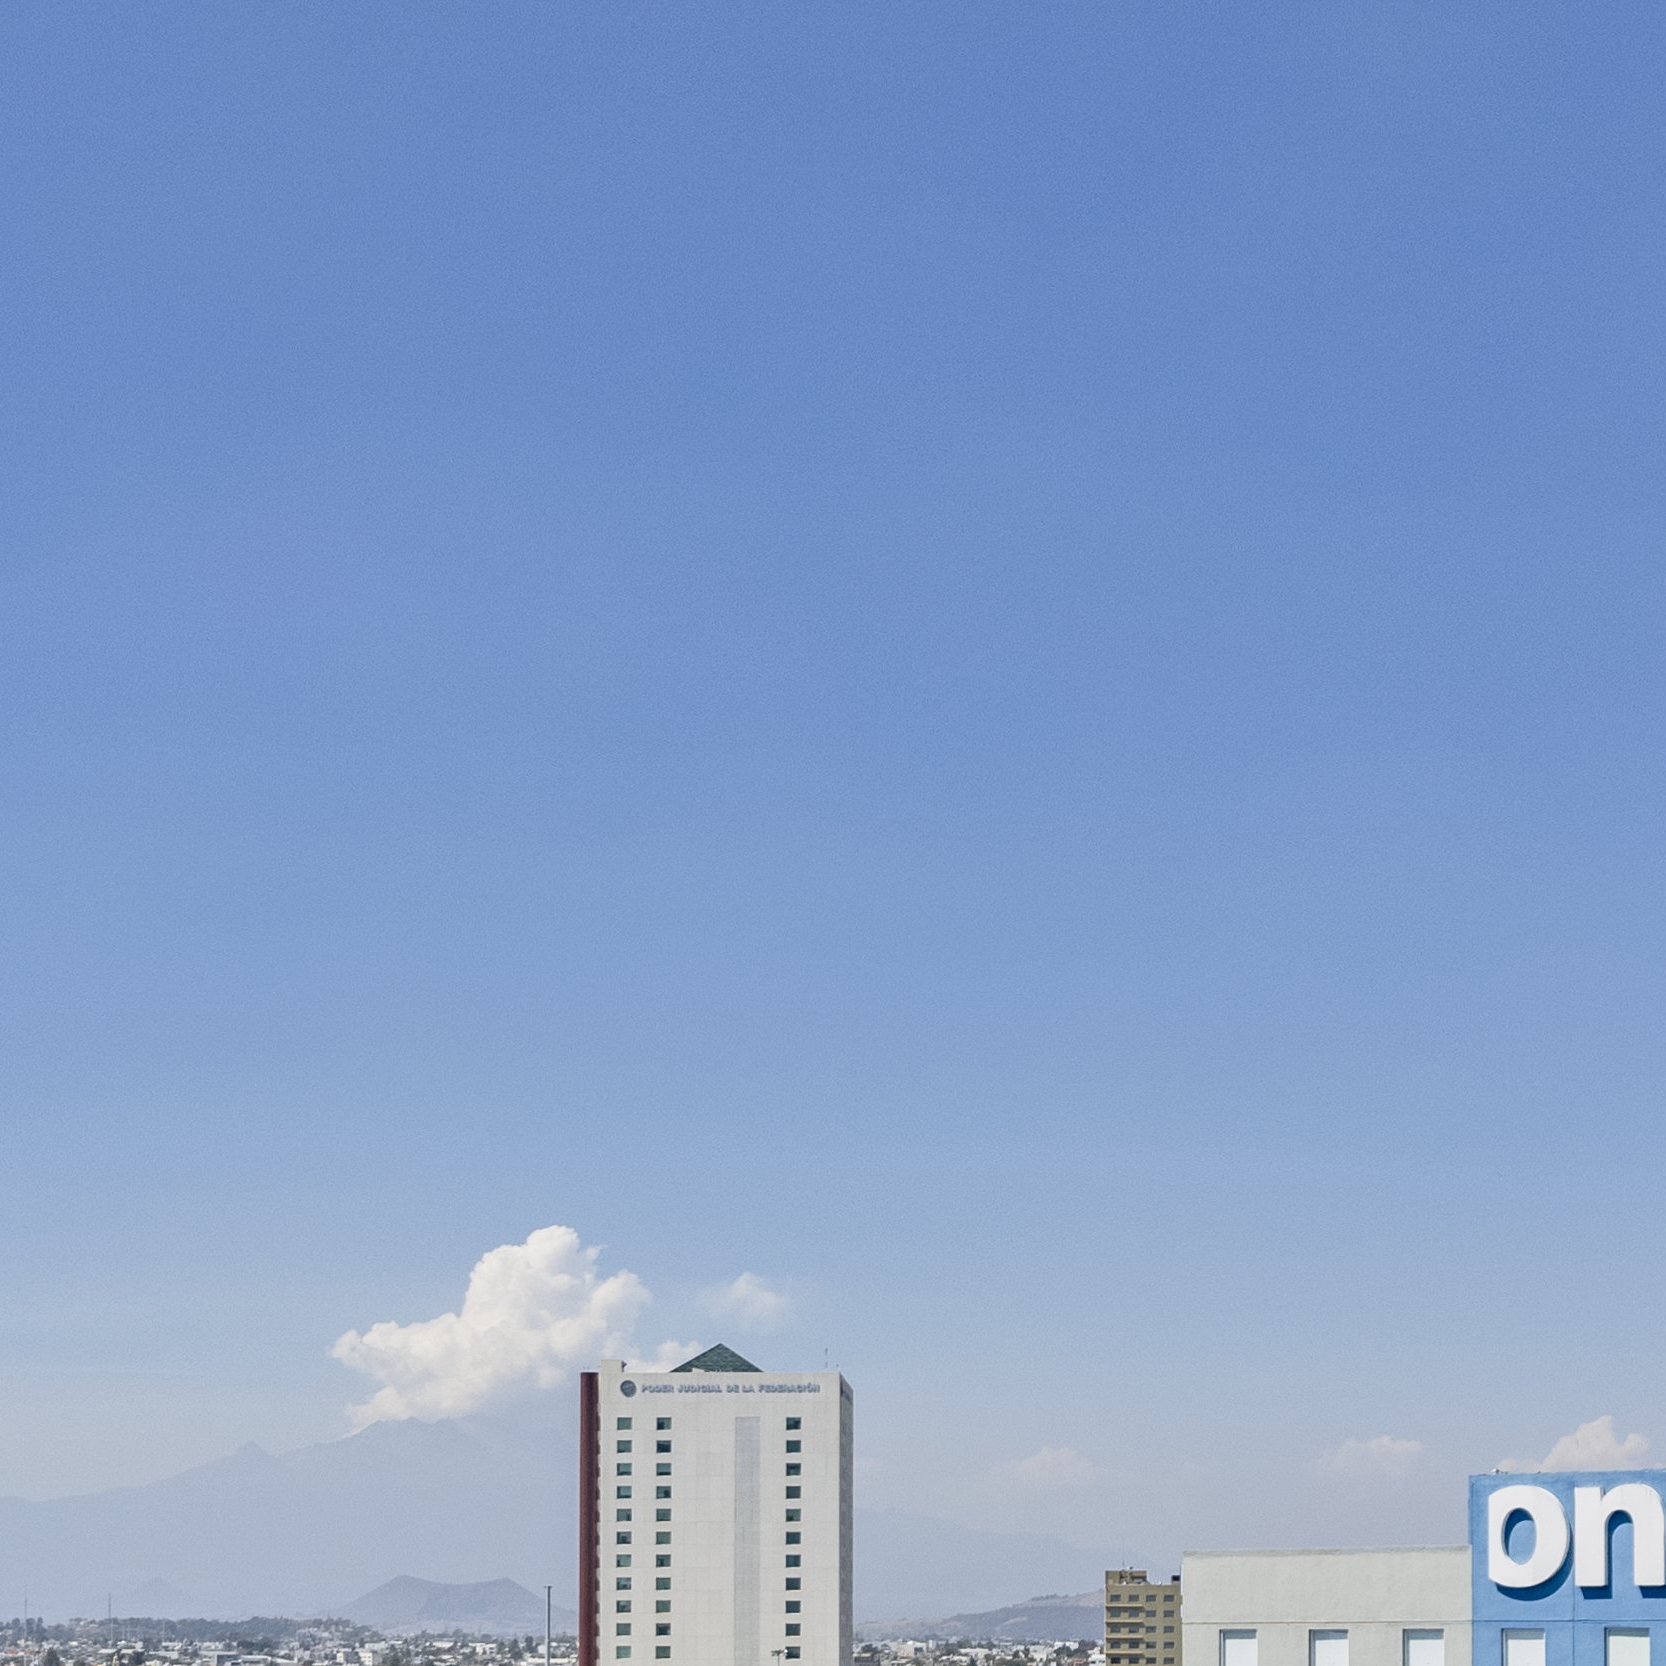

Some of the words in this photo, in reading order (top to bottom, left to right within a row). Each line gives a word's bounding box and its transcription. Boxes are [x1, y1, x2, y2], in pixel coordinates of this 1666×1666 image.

[641, 1383, 674, 1393] PODER
[677, 1383, 723, 1393] JUDICIAL
[726, 1383, 740, 1393] DE
[741, 1384, 755, 1393] LA
